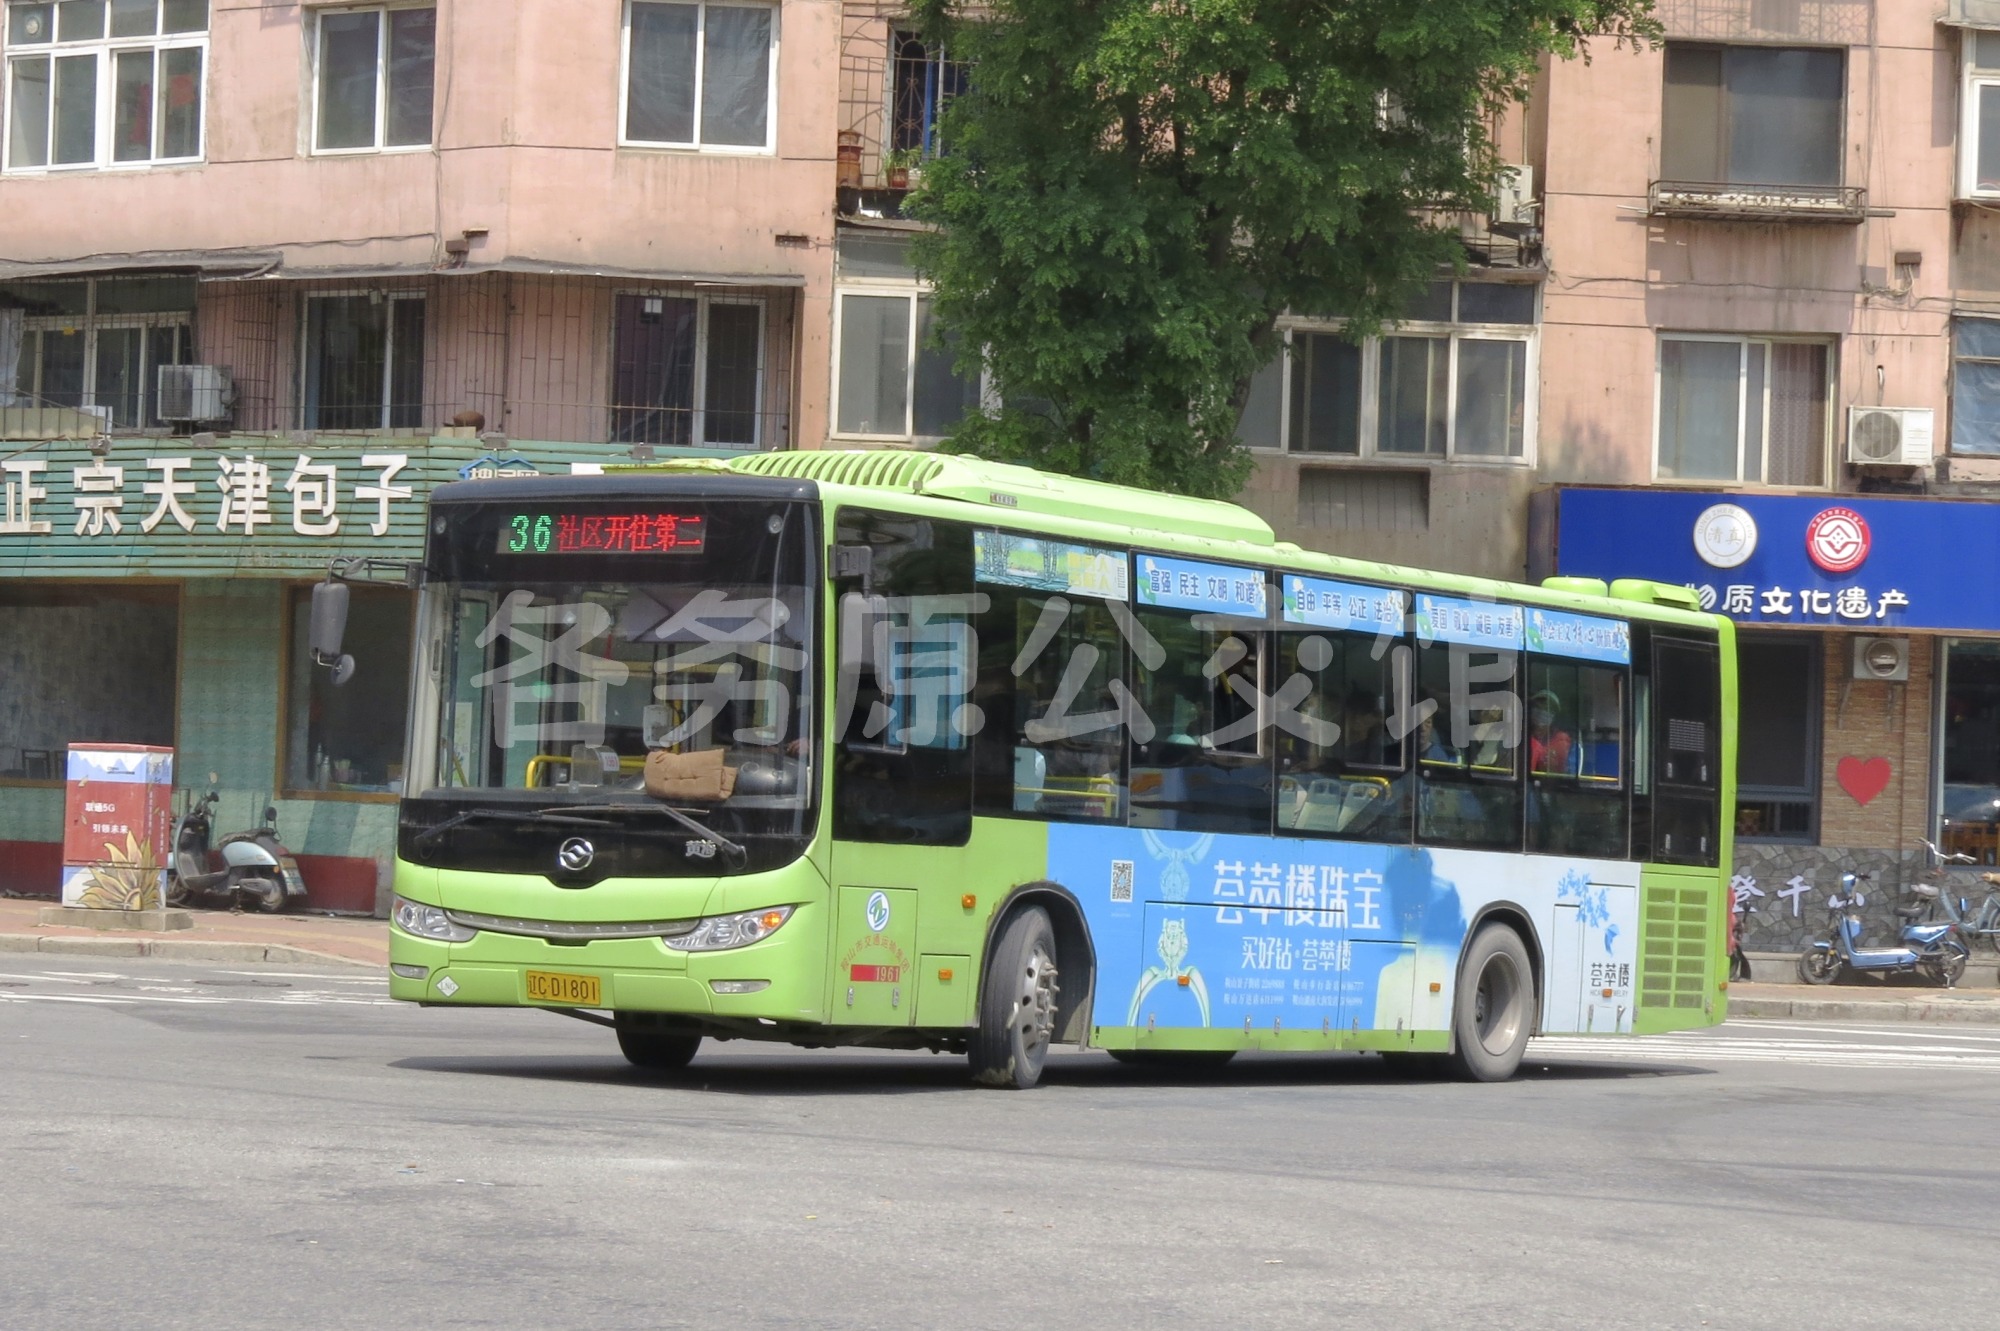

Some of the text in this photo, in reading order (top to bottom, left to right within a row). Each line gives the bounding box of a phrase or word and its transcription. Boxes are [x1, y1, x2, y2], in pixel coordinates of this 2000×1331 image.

[0, 453, 413, 536] 正宗天津包子
[510, 514, 702, 551] 36 社区开往第二
[1707, 526, 1742, 545] 清真
[1150, 569, 1172, 594] 富强
[1179, 573, 1200, 597] 民主
[1207, 577, 1228, 600] 文明
[1235, 581, 1256, 604] 和谐
[1297, 590, 1392, 622] 自由 平等 公正 法治
[1431, 608, 1513, 637] 爱国 敬业 诚信 友善
[85, 802, 116, 813] 联通5G
[92, 823, 129, 835] 引领未来
[1213, 859, 1383, 930] 荟萃楼珠宝
[440, 981, 455, 990] LNG
[876, 966, 899, 982] 1961
[1590, 963, 1629, 987] 荟萃楼
